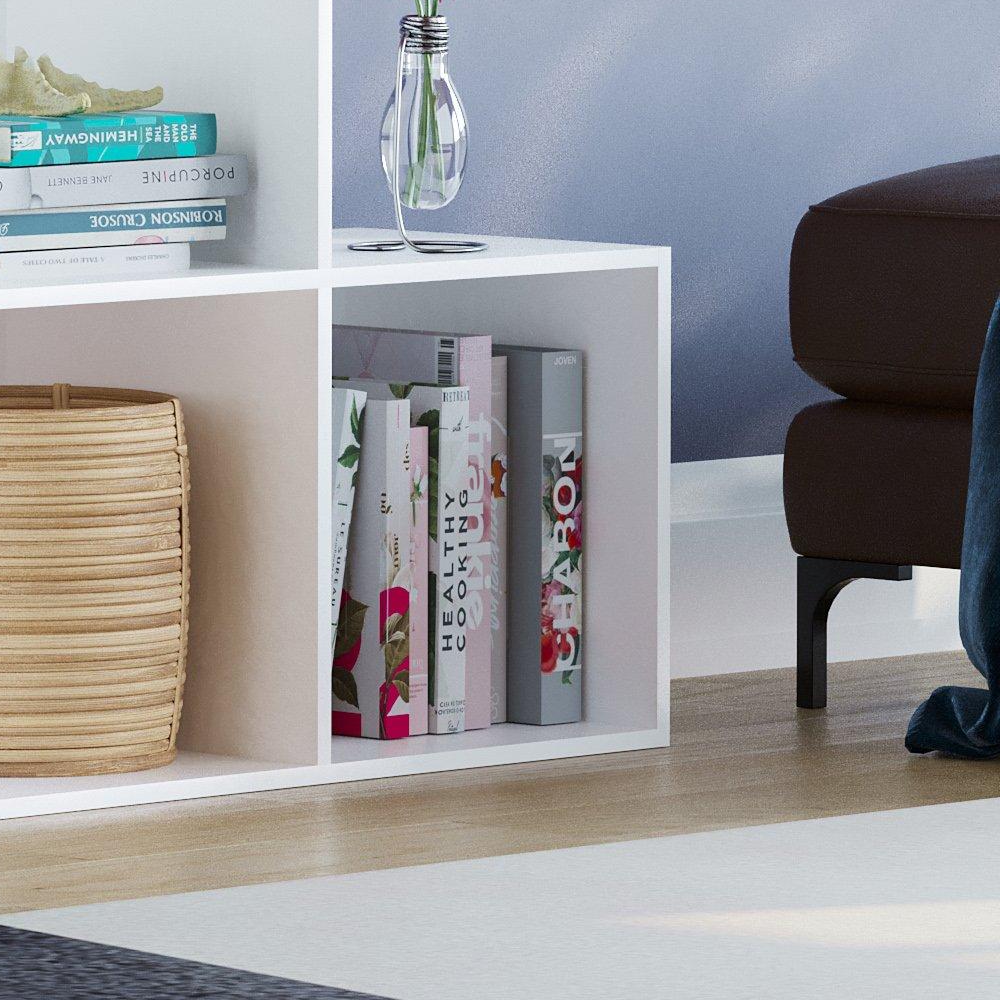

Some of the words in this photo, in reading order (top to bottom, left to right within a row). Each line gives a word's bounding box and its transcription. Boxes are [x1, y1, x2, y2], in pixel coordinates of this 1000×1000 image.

[45, 129, 137, 146] HEMINGWAY
[171, 124, 179, 143] MAN
[190, 123, 198, 141] THE
[48, 176, 88, 187] BENNETT
[90, 174, 113, 185] JANE
[142, 167, 235, 184] PORCUPINE
[89, 213, 147, 228] CRUSOE
[151, 209, 223, 225] ROBINSON
[553, 355, 577, 366] JOVEN
[552, 438, 578, 667] CHABON
[331, 547, 343, 607] SUREAU
[441, 491, 456, 652] HEALTHY
[456, 488, 469, 653] COOKING
